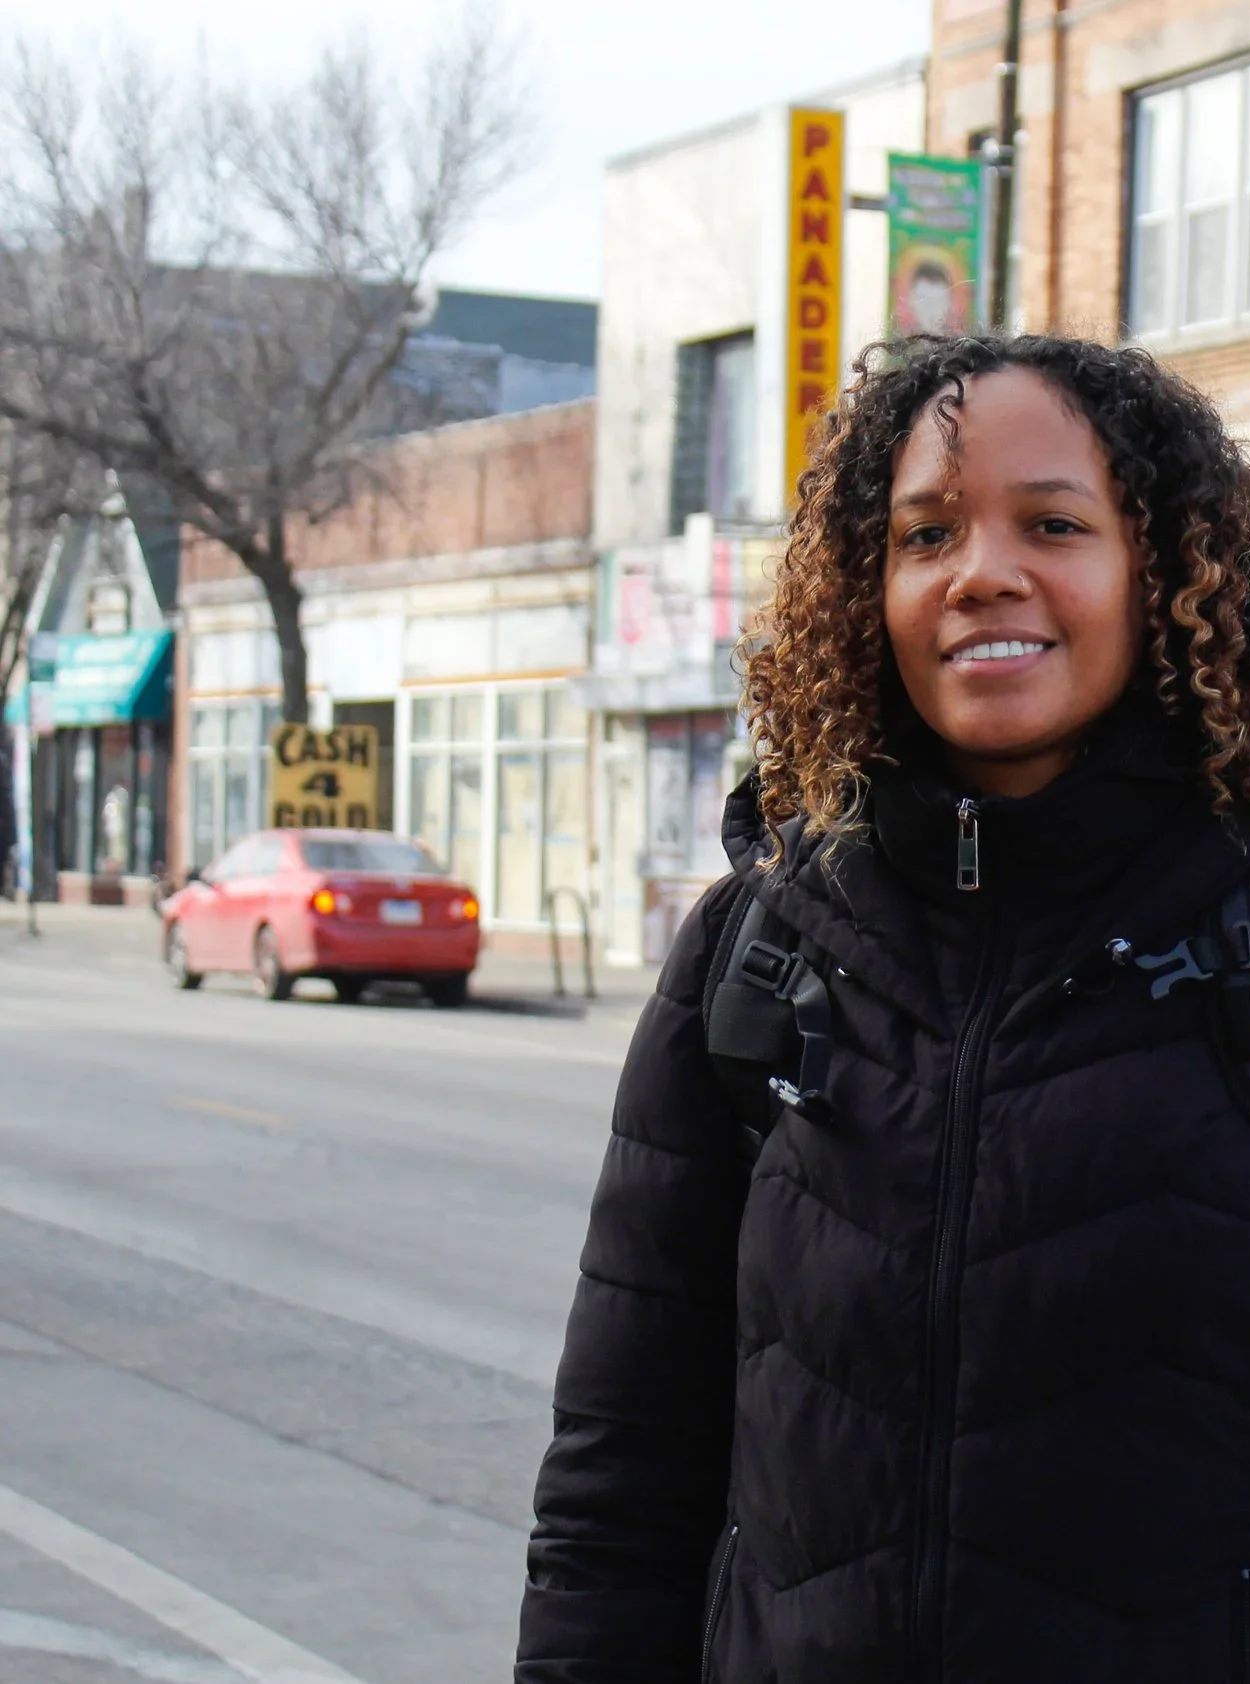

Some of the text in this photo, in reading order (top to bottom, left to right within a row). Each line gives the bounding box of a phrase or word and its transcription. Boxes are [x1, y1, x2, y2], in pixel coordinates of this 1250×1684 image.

[276, 725, 368, 767] CASH
[301, 771, 341, 797] 4
[274, 801, 368, 828] GOLD
